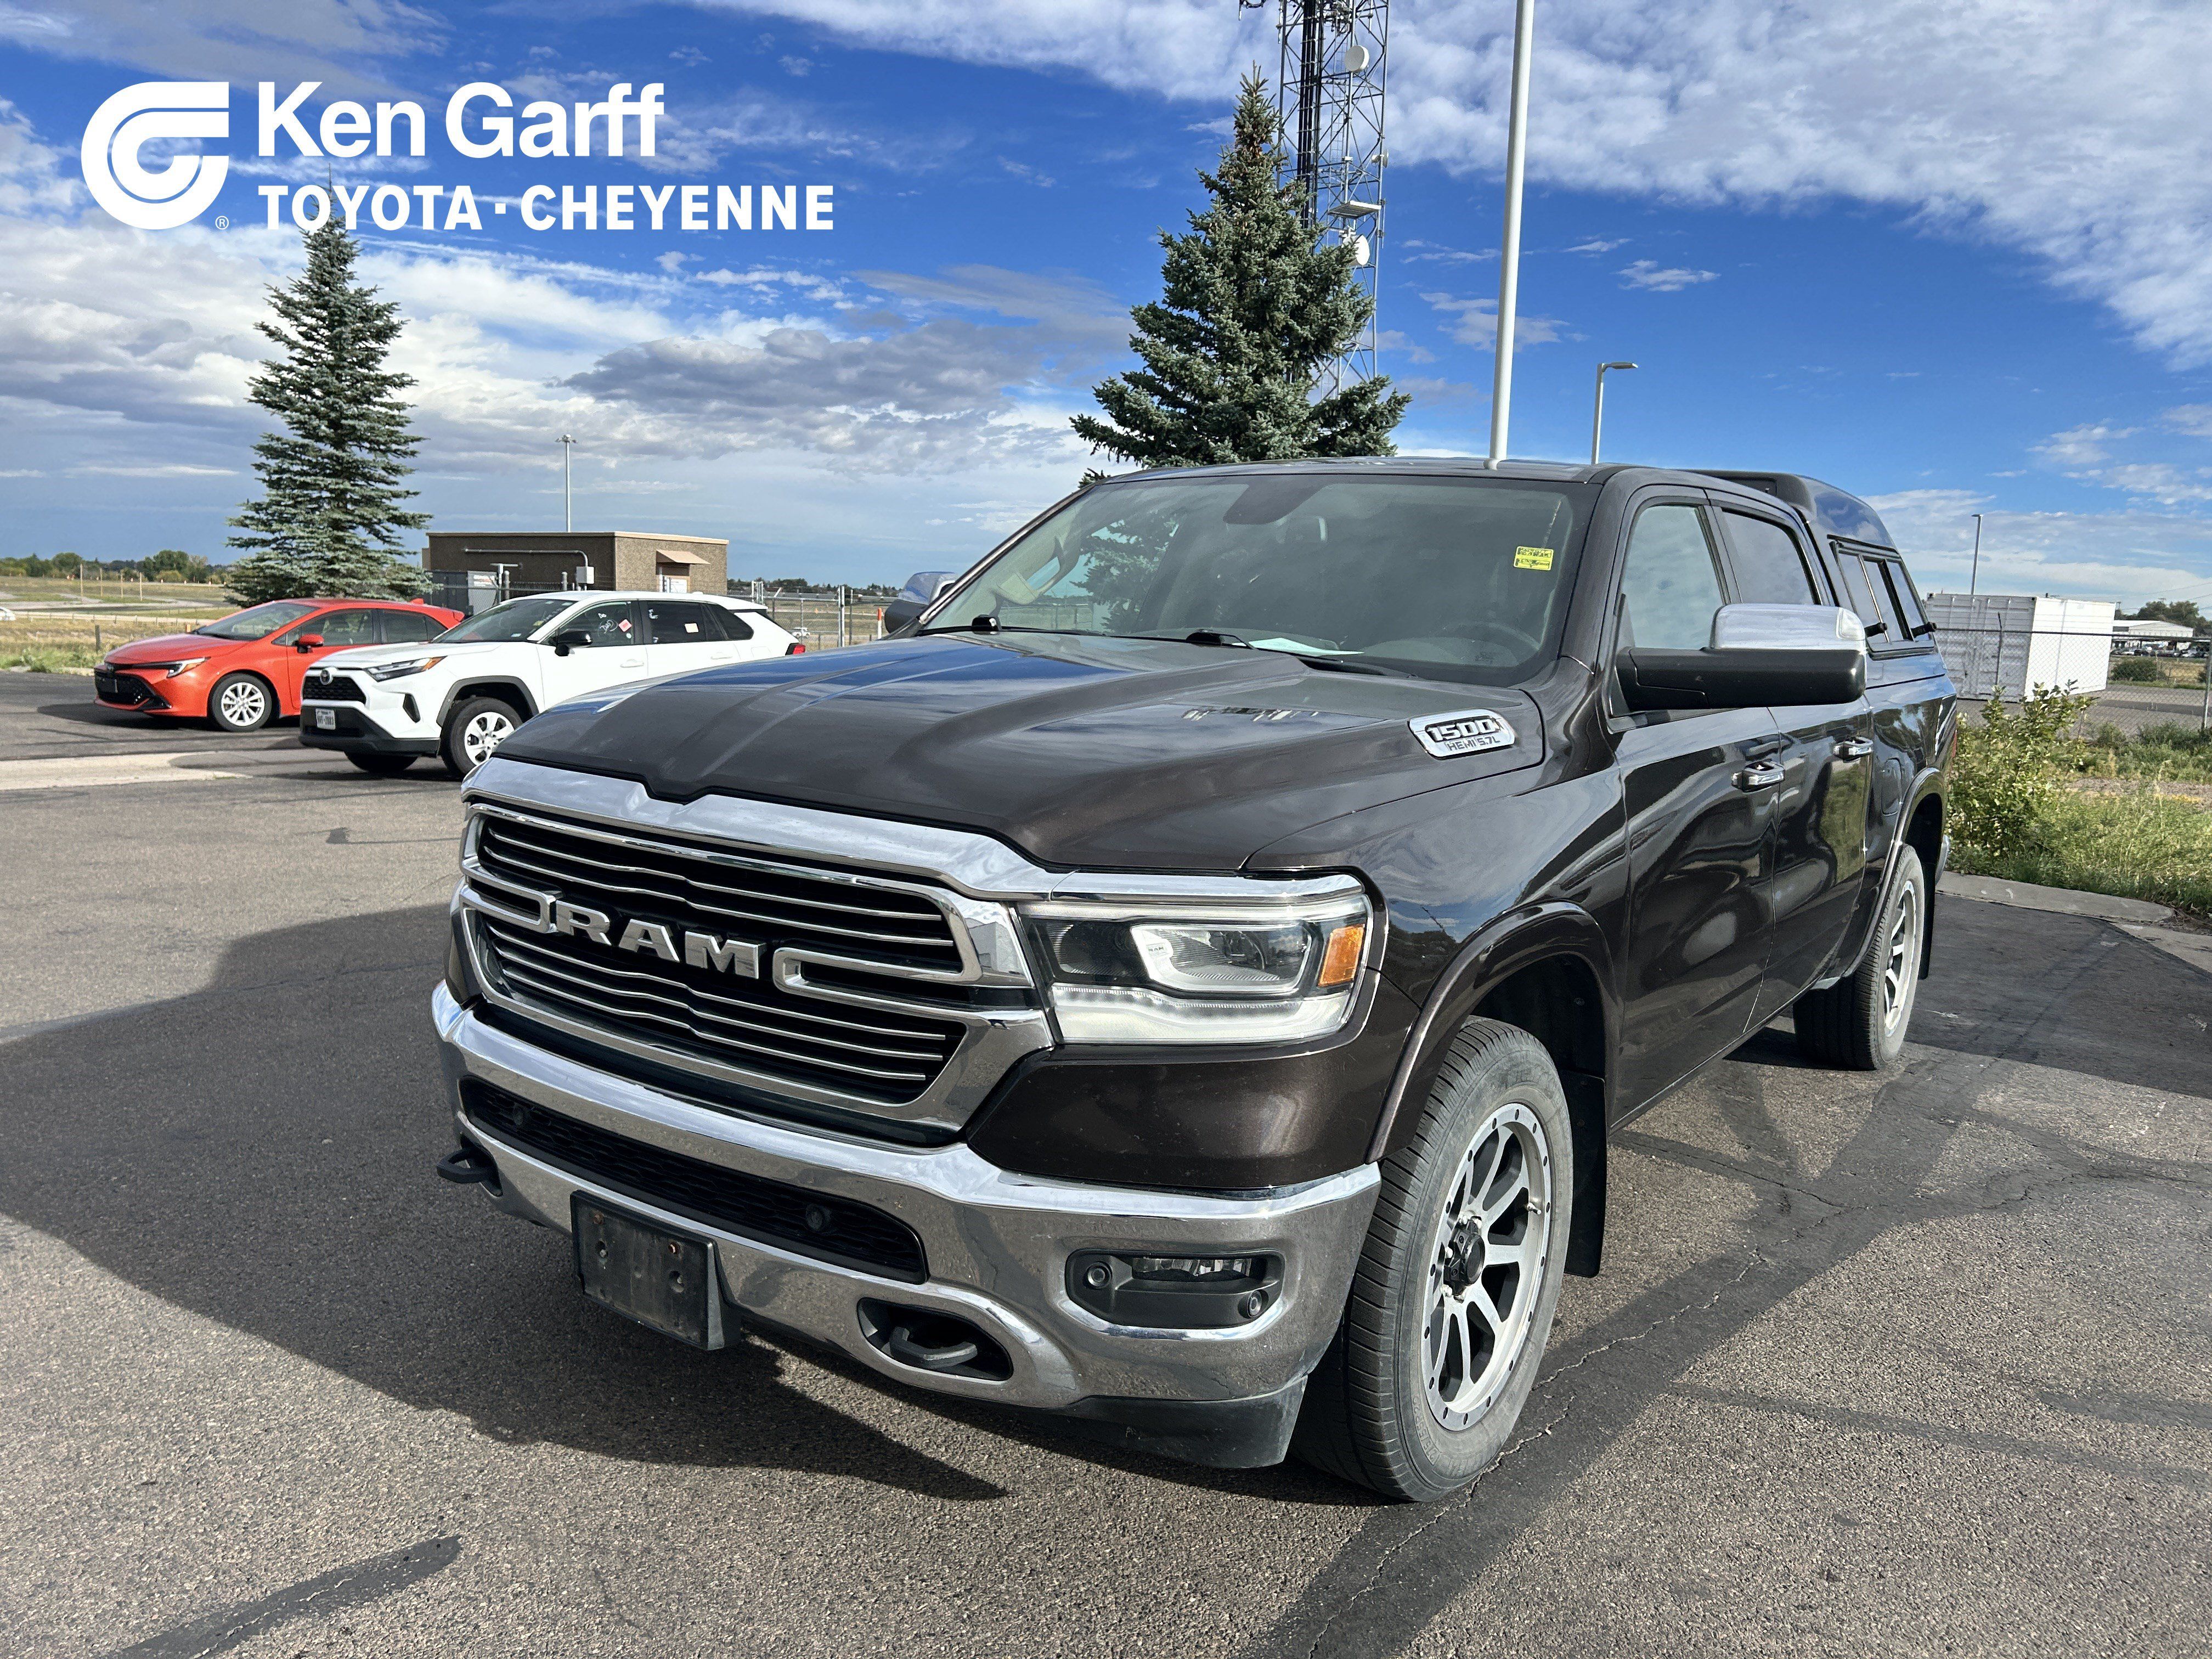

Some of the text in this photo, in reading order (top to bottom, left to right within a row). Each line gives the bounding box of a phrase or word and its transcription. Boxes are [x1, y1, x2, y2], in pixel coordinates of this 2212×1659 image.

[1427, 719, 1496, 741] 1500
[1446, 736, 1501, 751] HEMI 5.7L
[555, 899, 760, 980] RAM
